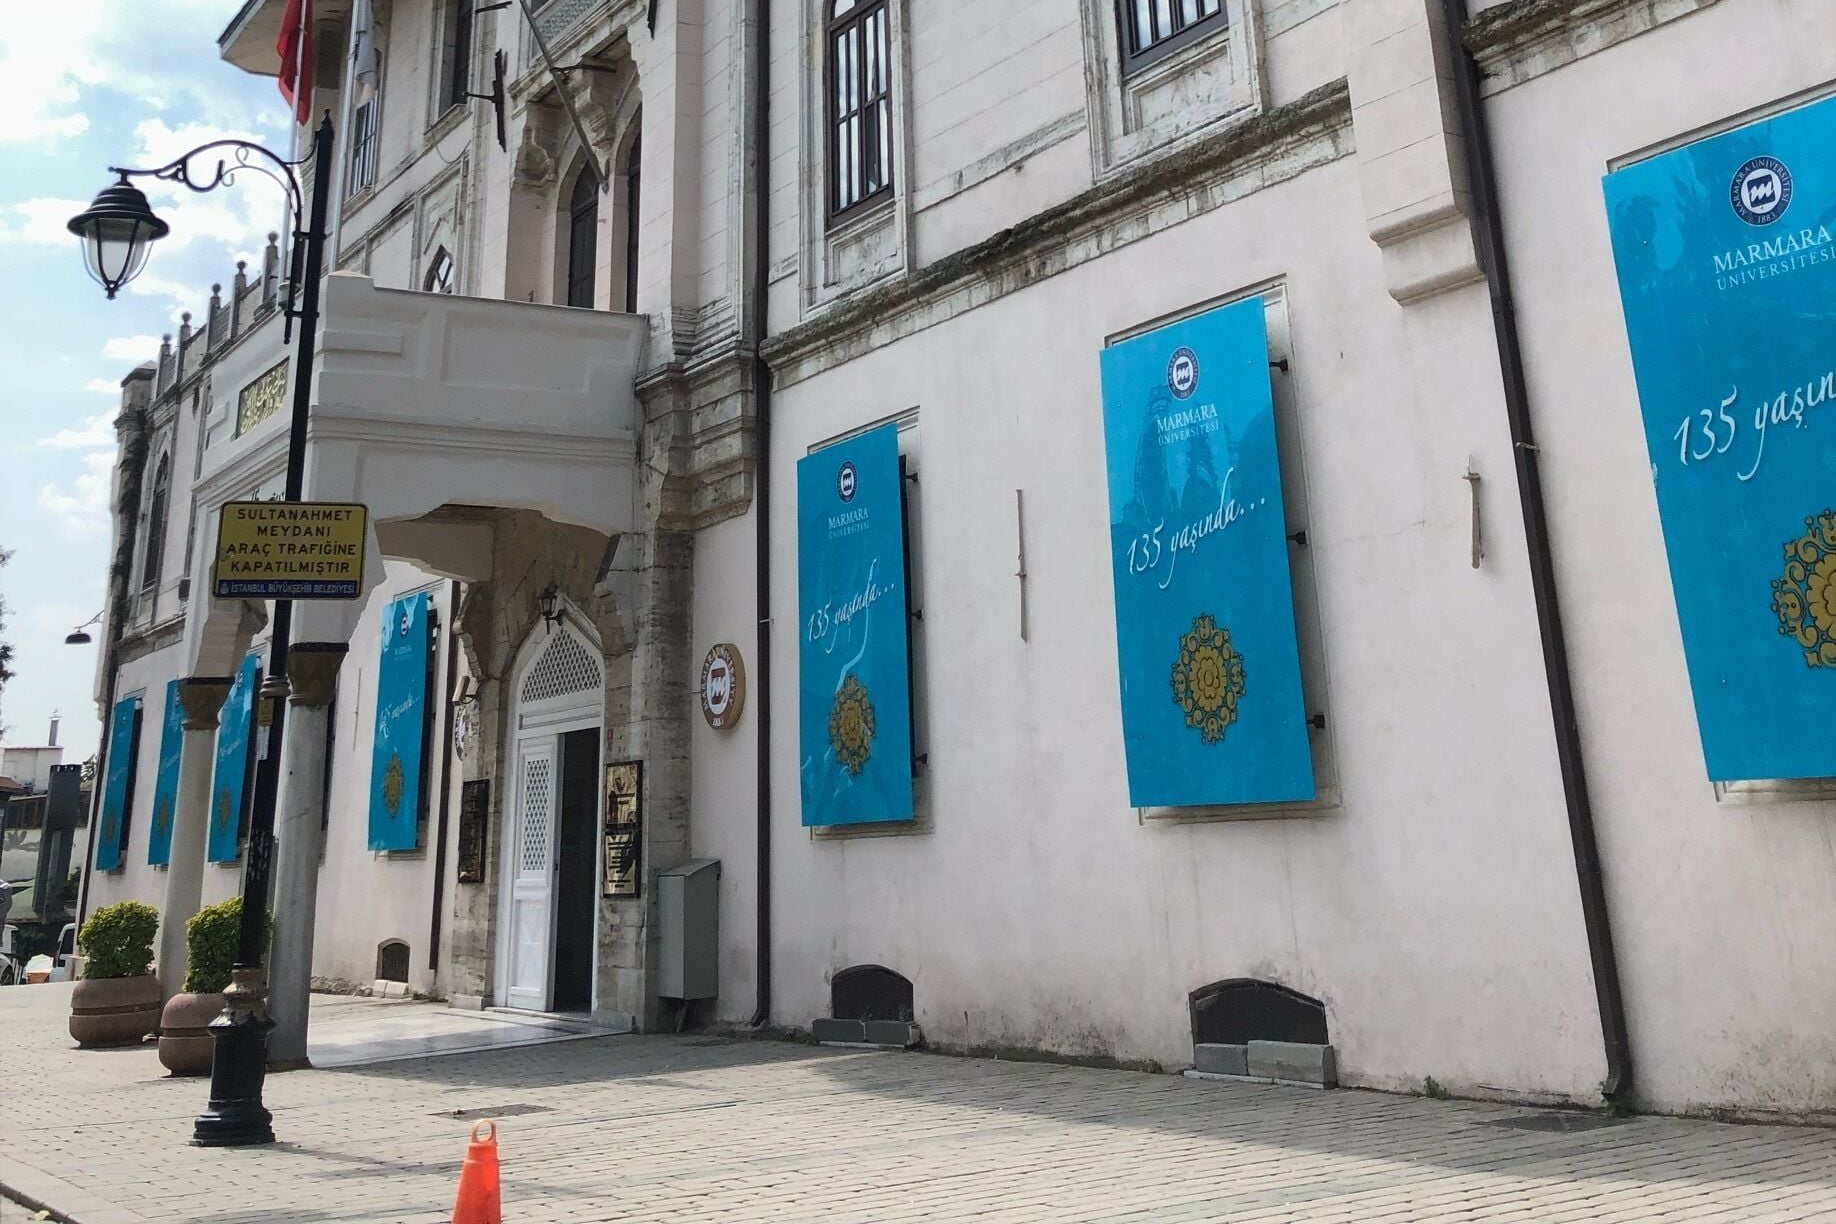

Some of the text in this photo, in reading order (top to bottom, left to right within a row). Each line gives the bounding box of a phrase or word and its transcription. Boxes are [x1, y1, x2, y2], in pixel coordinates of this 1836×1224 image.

[1712, 224, 1833, 274] MARMARA
[1156, 403, 1218, 434] MARMARA
[1674, 385, 1737, 466] 135
[237, 508, 353, 521] SULTANAHMET
[828, 507, 869, 530] MARMARA
[257, 525, 331, 537] MEYDANI
[226, 543, 272, 557] ARAÇ
[1127, 517, 1164, 575] 135
[230, 561, 350, 576] KAPATILMIŞTIR
[231, 582, 266, 593] İSTANBUL
[807, 599, 832, 642] 135
